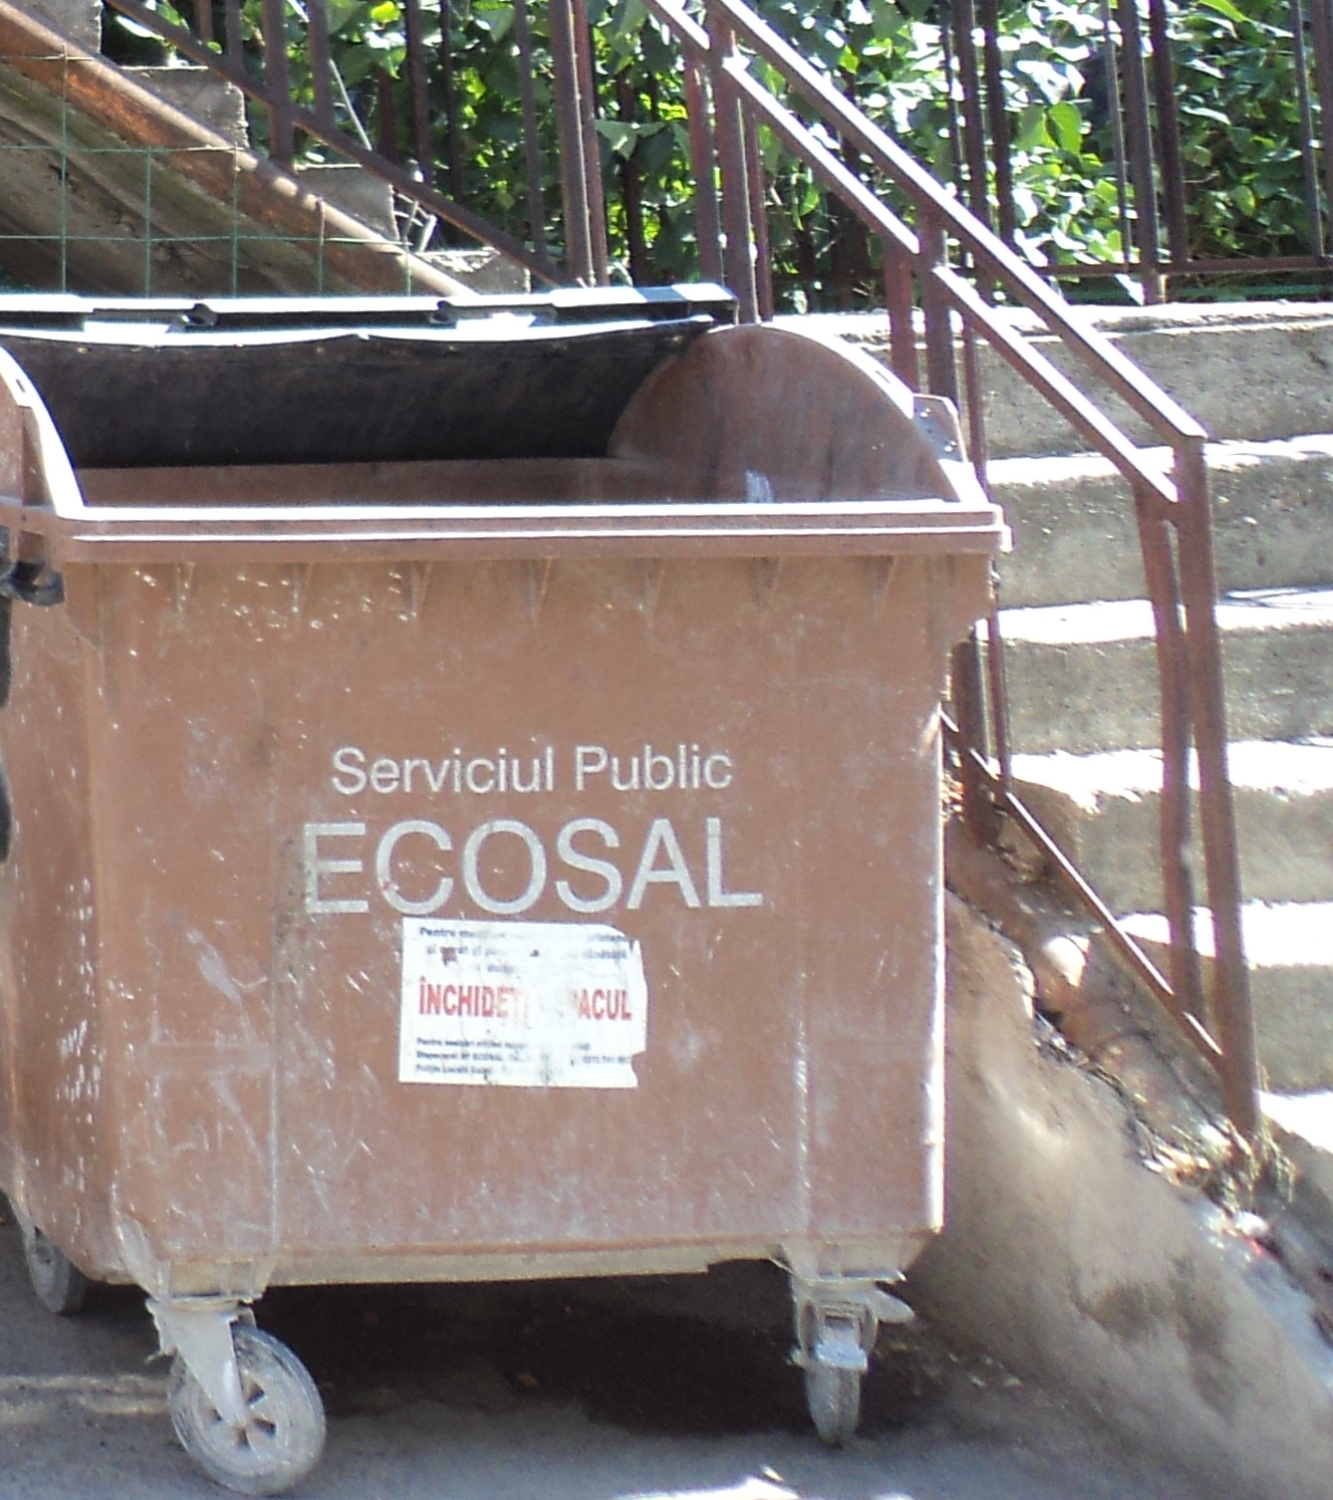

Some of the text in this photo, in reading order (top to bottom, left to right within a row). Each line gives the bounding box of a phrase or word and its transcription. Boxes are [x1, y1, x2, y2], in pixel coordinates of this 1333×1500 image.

[332, 743, 733, 795] Serviciul Public
[301, 816, 764, 915] ECOSAL
[418, 975, 528, 1018] ÎNCHIDE
